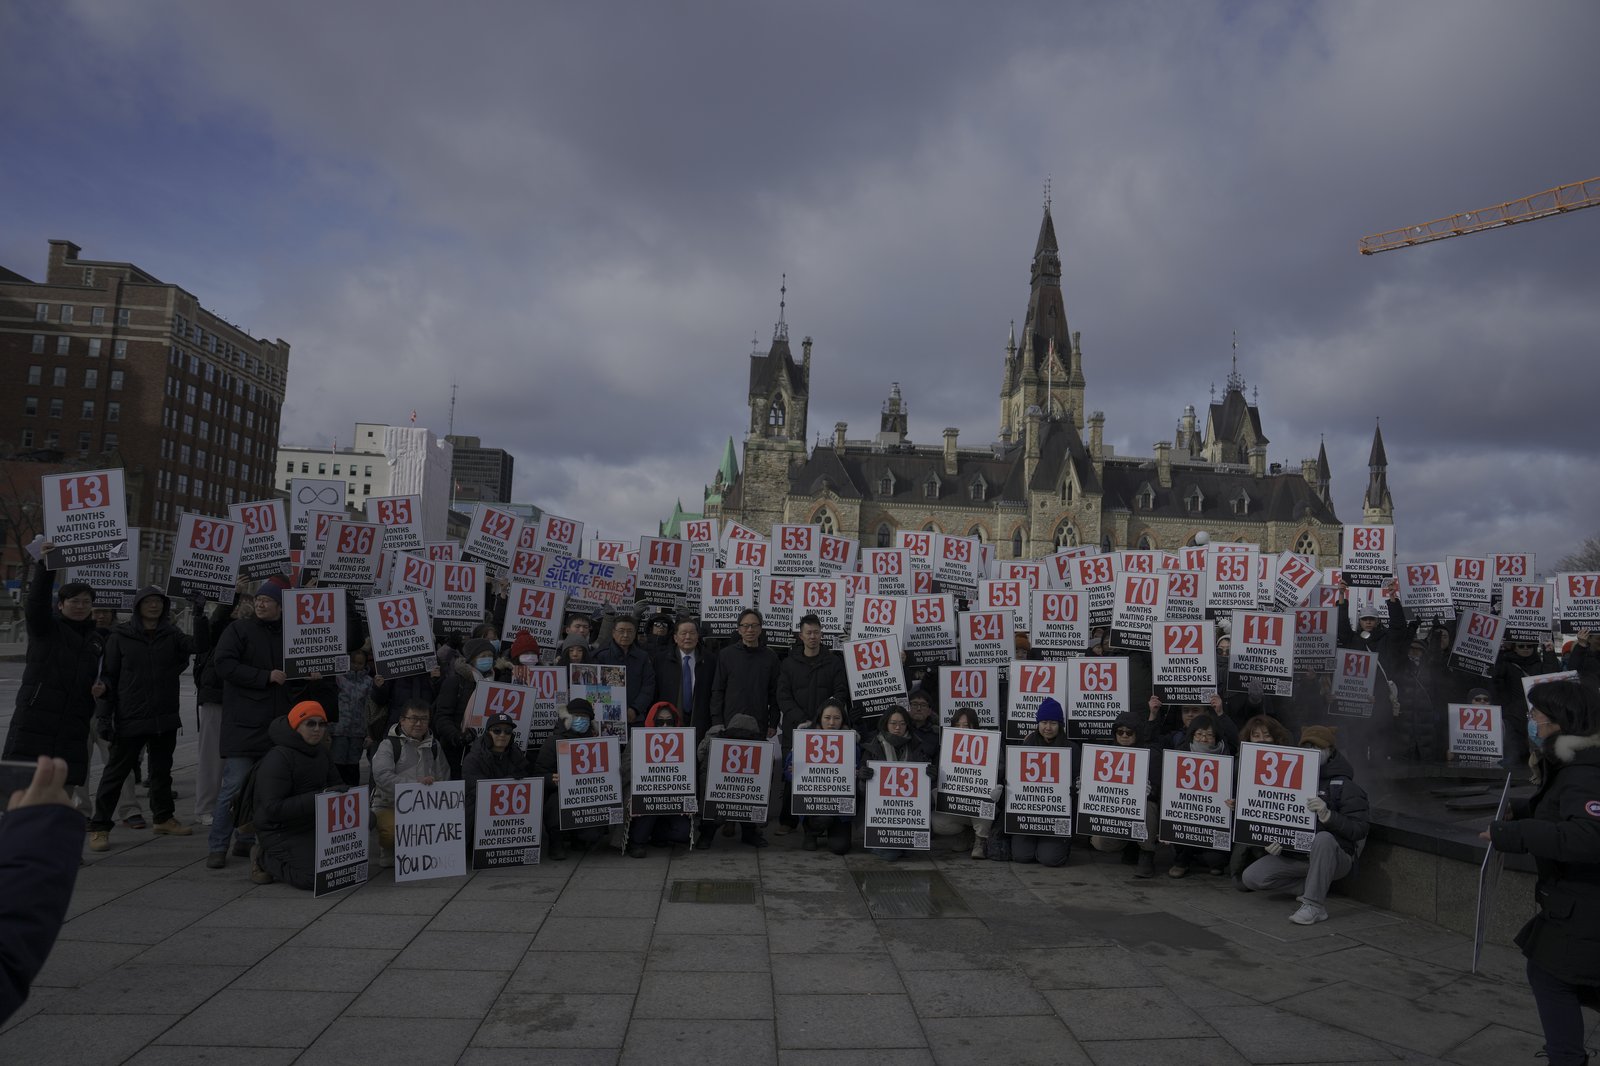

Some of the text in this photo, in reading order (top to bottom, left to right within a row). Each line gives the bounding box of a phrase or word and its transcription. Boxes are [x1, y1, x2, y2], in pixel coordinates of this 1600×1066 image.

[67, 477, 103, 509] 13
[66, 511, 105, 522] MONTHS
[246, 506, 272, 534] 30
[382, 500, 408, 524] 35
[52, 528, 121, 543] IRCC RESPONSE
[57, 520, 116, 533] WAITING FOR
[195, 521, 228, 551] 30
[485, 511, 511, 539] 42
[550, 520, 572, 543] 39
[690, 523, 708, 541] 25
[342, 526, 370, 553] 36
[784, 528, 808, 551] 53
[906, 535, 926, 555] 25
[945, 539, 968, 562] 33
[1357, 529, 1380, 550] 38
[192, 552, 224, 563] MONTHS
[601, 543, 620, 561] 27
[653, 543, 676, 566] 11
[739, 544, 762, 566] 15
[876, 553, 898, 574] 68
[176, 568, 233, 581] IRCC RESPONSE
[182, 560, 214, 570] WAITING
[407, 558, 430, 586] 20
[553, 555, 615, 578] STOP THE
[1084, 558, 1109, 584] 33
[1220, 556, 1244, 581] 35
[1283, 560, 1311, 584] 27
[1412, 566, 1435, 585] 32
[1458, 560, 1480, 580] 19
[1500, 556, 1522, 575] 28
[448, 567, 472, 592] 40
[716, 574, 740, 596] 71
[1132, 578, 1154, 604] 70
[1171, 574, 1194, 597] 23
[1573, 576, 1599, 596] 37
[524, 590, 550, 618] 54
[808, 583, 832, 607] 63
[993, 583, 1016, 606] 55
[1516, 586, 1540, 606] 37
[301, 594, 330, 624] 34
[384, 599, 414, 628] 38
[868, 600, 892, 624] 68
[916, 599, 941, 623] 55
[1047, 596, 1074, 620] 90
[301, 627, 330, 636] MONTHS
[387, 629, 416, 639] MONTHS
[974, 616, 999, 640] 34
[1249, 616, 1276, 645] 11
[1299, 612, 1325, 633] 31
[1472, 618, 1494, 638] 30
[293, 637, 322, 646] WAITING
[306, 644, 342, 654] RESPONSE
[378, 643, 430, 658] IRCC RESPONSE
[381, 638, 410, 649] WAITING
[1169, 626, 1198, 654] 22
[306, 657, 335, 665] TIMELINES
[396, 656, 425, 667] TIMELINES
[858, 642, 885, 671] 39
[400, 664, 424, 673] RESULTS
[1024, 666, 1050, 693] 72
[1085, 664, 1112, 690] 65
[956, 672, 982, 698] 40
[490, 690, 521, 718] 42
[1463, 709, 1488, 730] 22
[576, 744, 605, 774] 31
[650, 734, 678, 763] 62
[726, 745, 756, 774] 81
[810, 736, 839, 764] 35
[956, 736, 984, 765] 40
[1026, 753, 1054, 782] 51
[1098, 752, 1130, 783] 34
[1181, 758, 1214, 791] 36
[1260, 752, 1298, 787] 37
[884, 768, 913, 796] 43
[1097, 786, 1128, 795] MONTHS
[396, 790, 465, 814] CANADA
[495, 786, 526, 815] 36
[1088, 795, 1119, 804] WAITING
[1248, 799, 1305, 813] WAITING FOR
[1258, 790, 1295, 801] MONTHS
[334, 795, 356, 831] 18
[1083, 803, 1140, 816] IRCC RESPONSE
[1242, 809, 1310, 825] IRCC RESPONSE
[484, 828, 515, 837] WAITING
[493, 818, 524, 827] MONTHS
[1100, 818, 1132, 827] TIMELINES
[1102, 827, 1129, 835] RESULTS
[396, 823, 462, 847] WHAT ARE
[497, 835, 536, 845] RESPONSE
[396, 854, 418, 875] YOU
